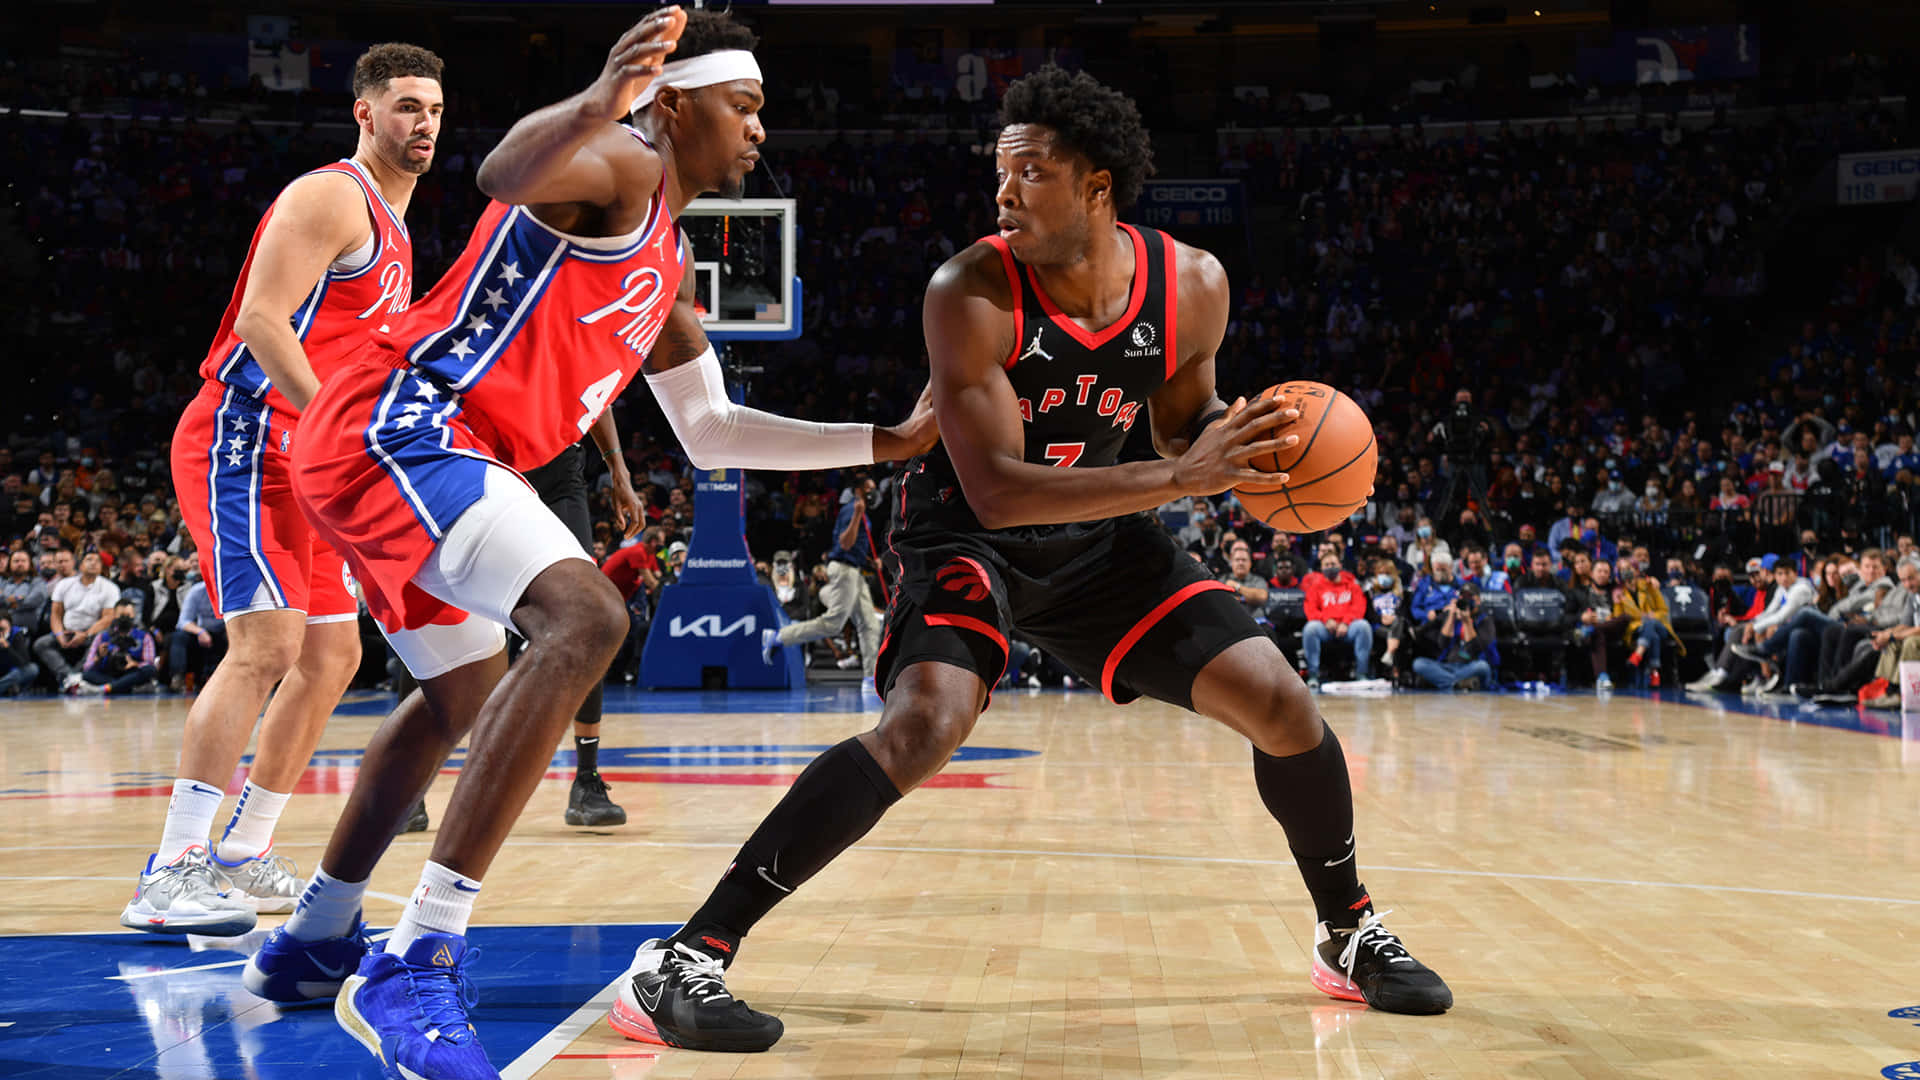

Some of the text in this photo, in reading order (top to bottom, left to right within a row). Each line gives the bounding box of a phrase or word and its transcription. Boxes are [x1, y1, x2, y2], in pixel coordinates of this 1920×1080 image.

[1151, 186, 1228, 202] GEICO
[356, 261, 412, 319] Phil
[577, 267, 667, 362] Phil
[1124, 346, 1161, 357] Sun Life
[577, 369, 623, 435] 4
[1018, 374, 1143, 432] APTORS
[697, 482, 738, 492] BETMGM
[687, 558, 747, 568] ticketmaster
